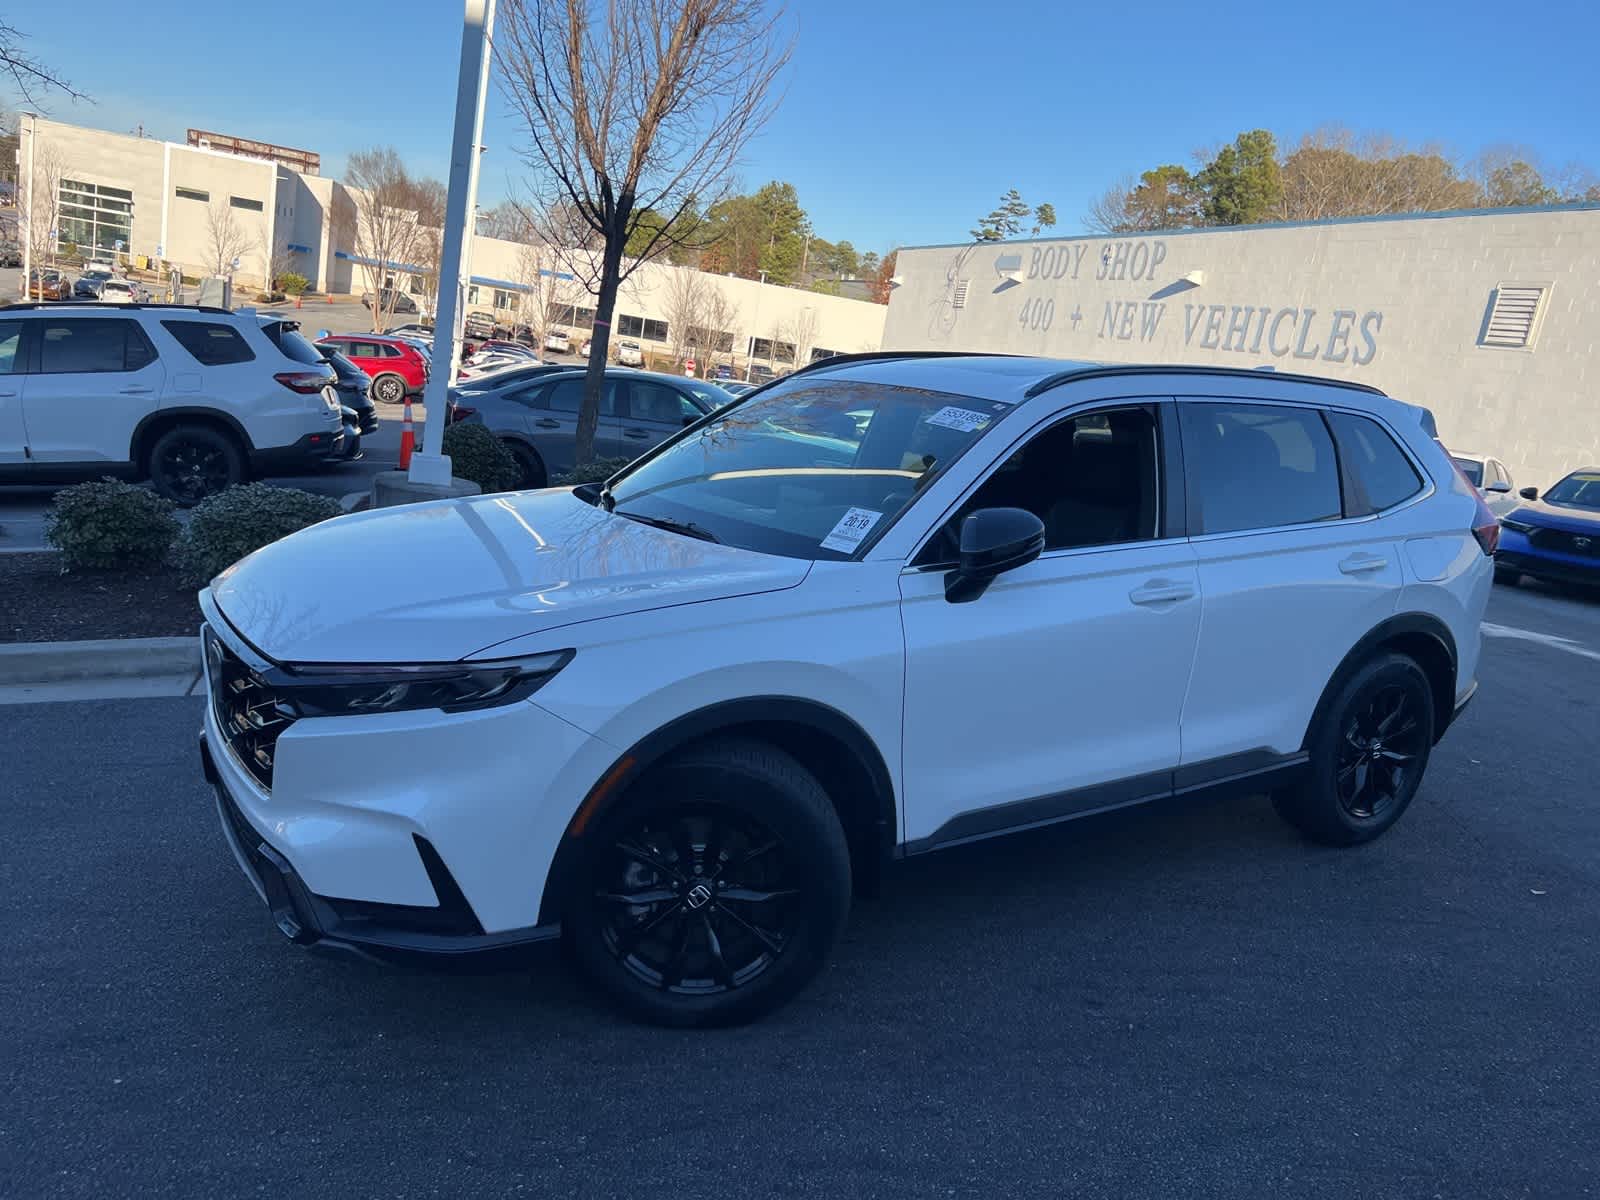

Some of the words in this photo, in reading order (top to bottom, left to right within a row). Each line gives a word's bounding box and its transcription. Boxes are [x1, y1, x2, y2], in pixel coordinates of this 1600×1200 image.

[1027, 244, 1088, 280] BODY
[1096, 240, 1167, 281] SHOP
[1018, 298, 1055, 333] 400
[1097, 301, 1166, 343] NEW
[1183, 304, 1384, 366] VEHICLES
